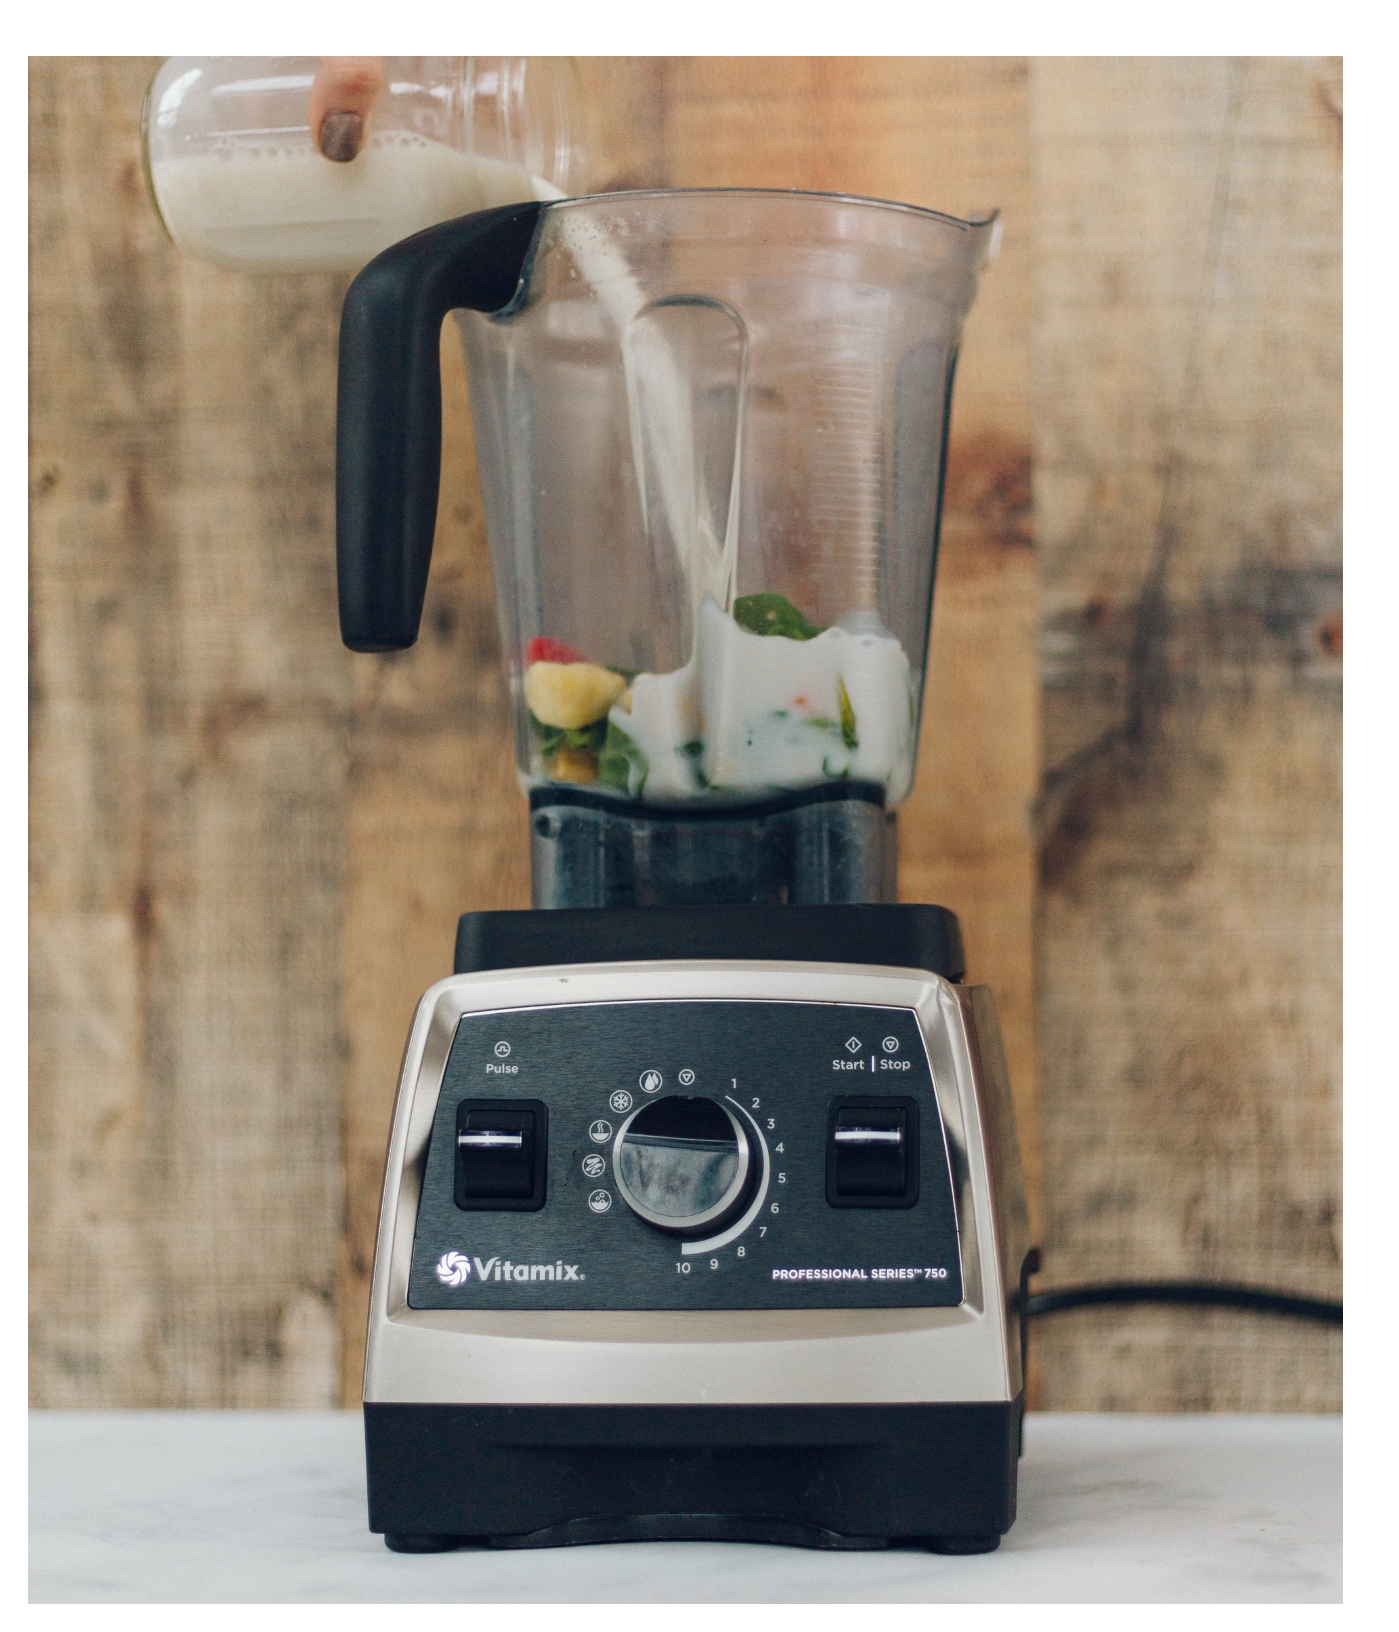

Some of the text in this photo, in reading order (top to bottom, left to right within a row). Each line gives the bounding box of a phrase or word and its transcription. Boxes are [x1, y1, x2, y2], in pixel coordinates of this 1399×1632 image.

[485, 1062, 519, 1074] Pulse
[832, 1058, 911, 1072] Start Stop
[751, 1097, 760, 1109] 2
[767, 1118, 775, 1130] 3
[775, 1142, 785, 1154] 4
[777, 1172, 787, 1184] 5
[770, 1202, 780, 1214] 6
[759, 1226, 768, 1238] 7
[736, 1245, 746, 1257] 8
[675, 1262, 691, 1274] 10
[709, 1258, 719, 1270] 9
[772, 1268, 868, 1280] PROFESSIONAL
[924, 1267, 947, 1279] 750
